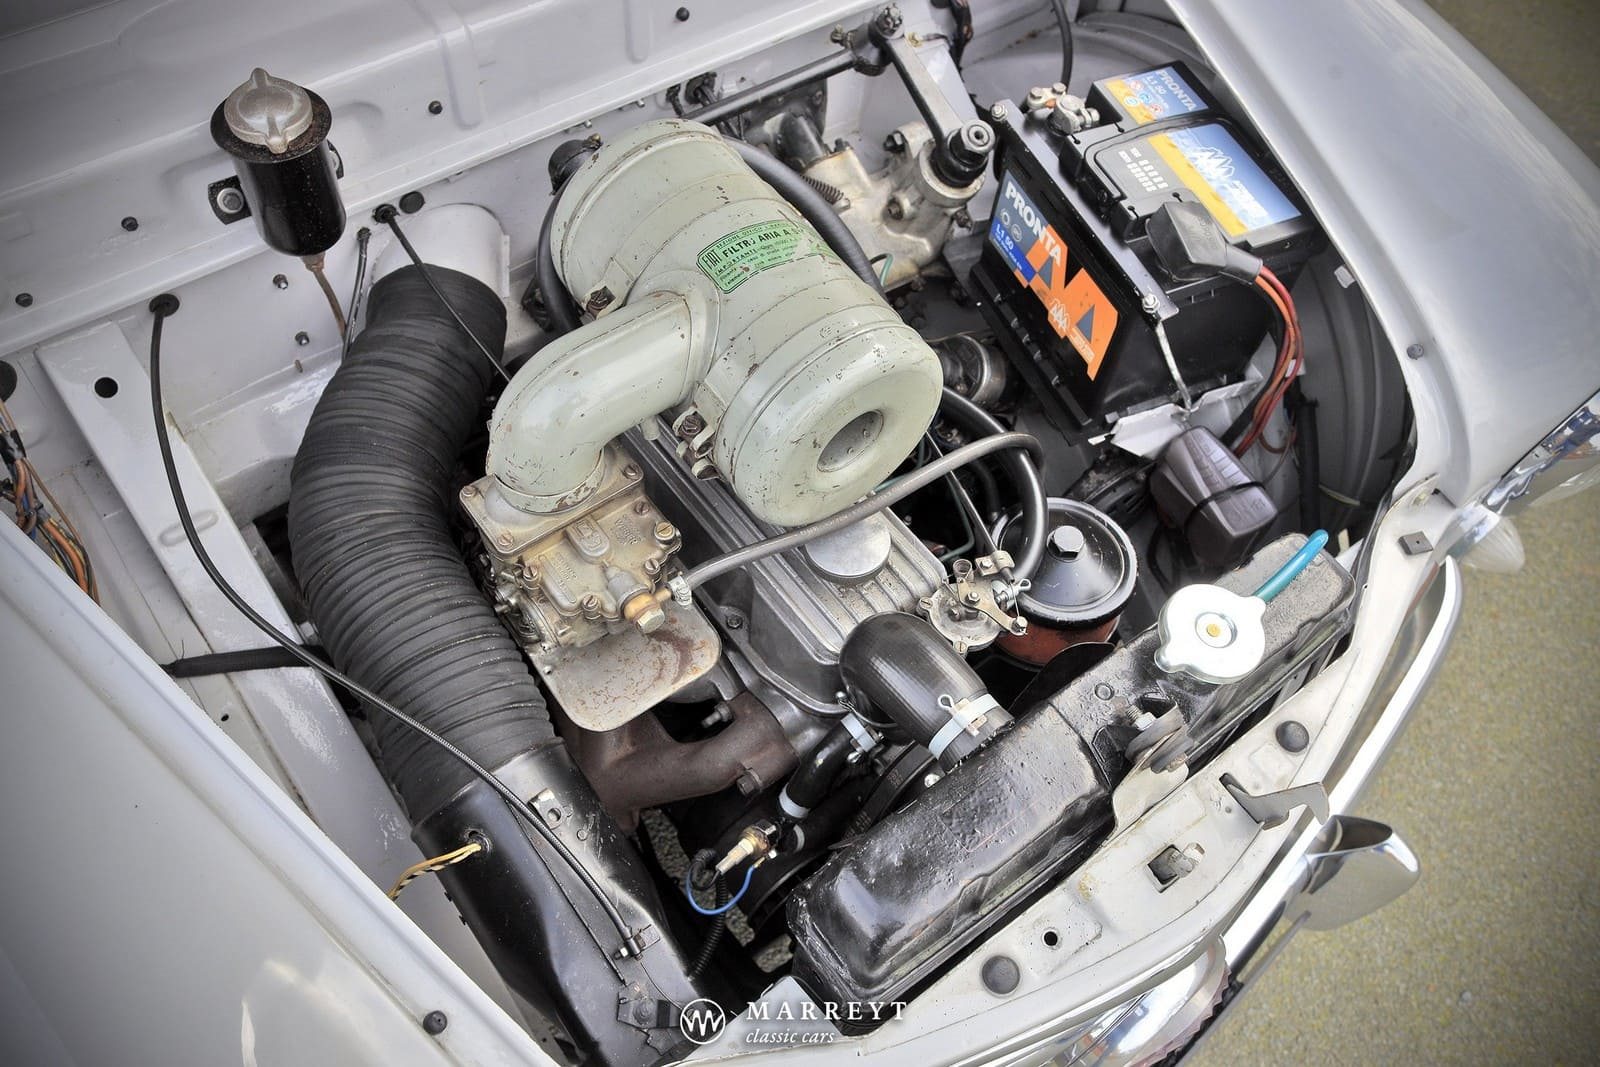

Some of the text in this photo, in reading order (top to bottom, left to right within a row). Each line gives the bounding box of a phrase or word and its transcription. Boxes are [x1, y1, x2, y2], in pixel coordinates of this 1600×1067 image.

[1160, 70, 1197, 111] PRONTA
[758, 230, 781, 243] ARIA
[1005, 181, 1061, 267] PRONTA
[701, 248, 721, 271] FIAT
